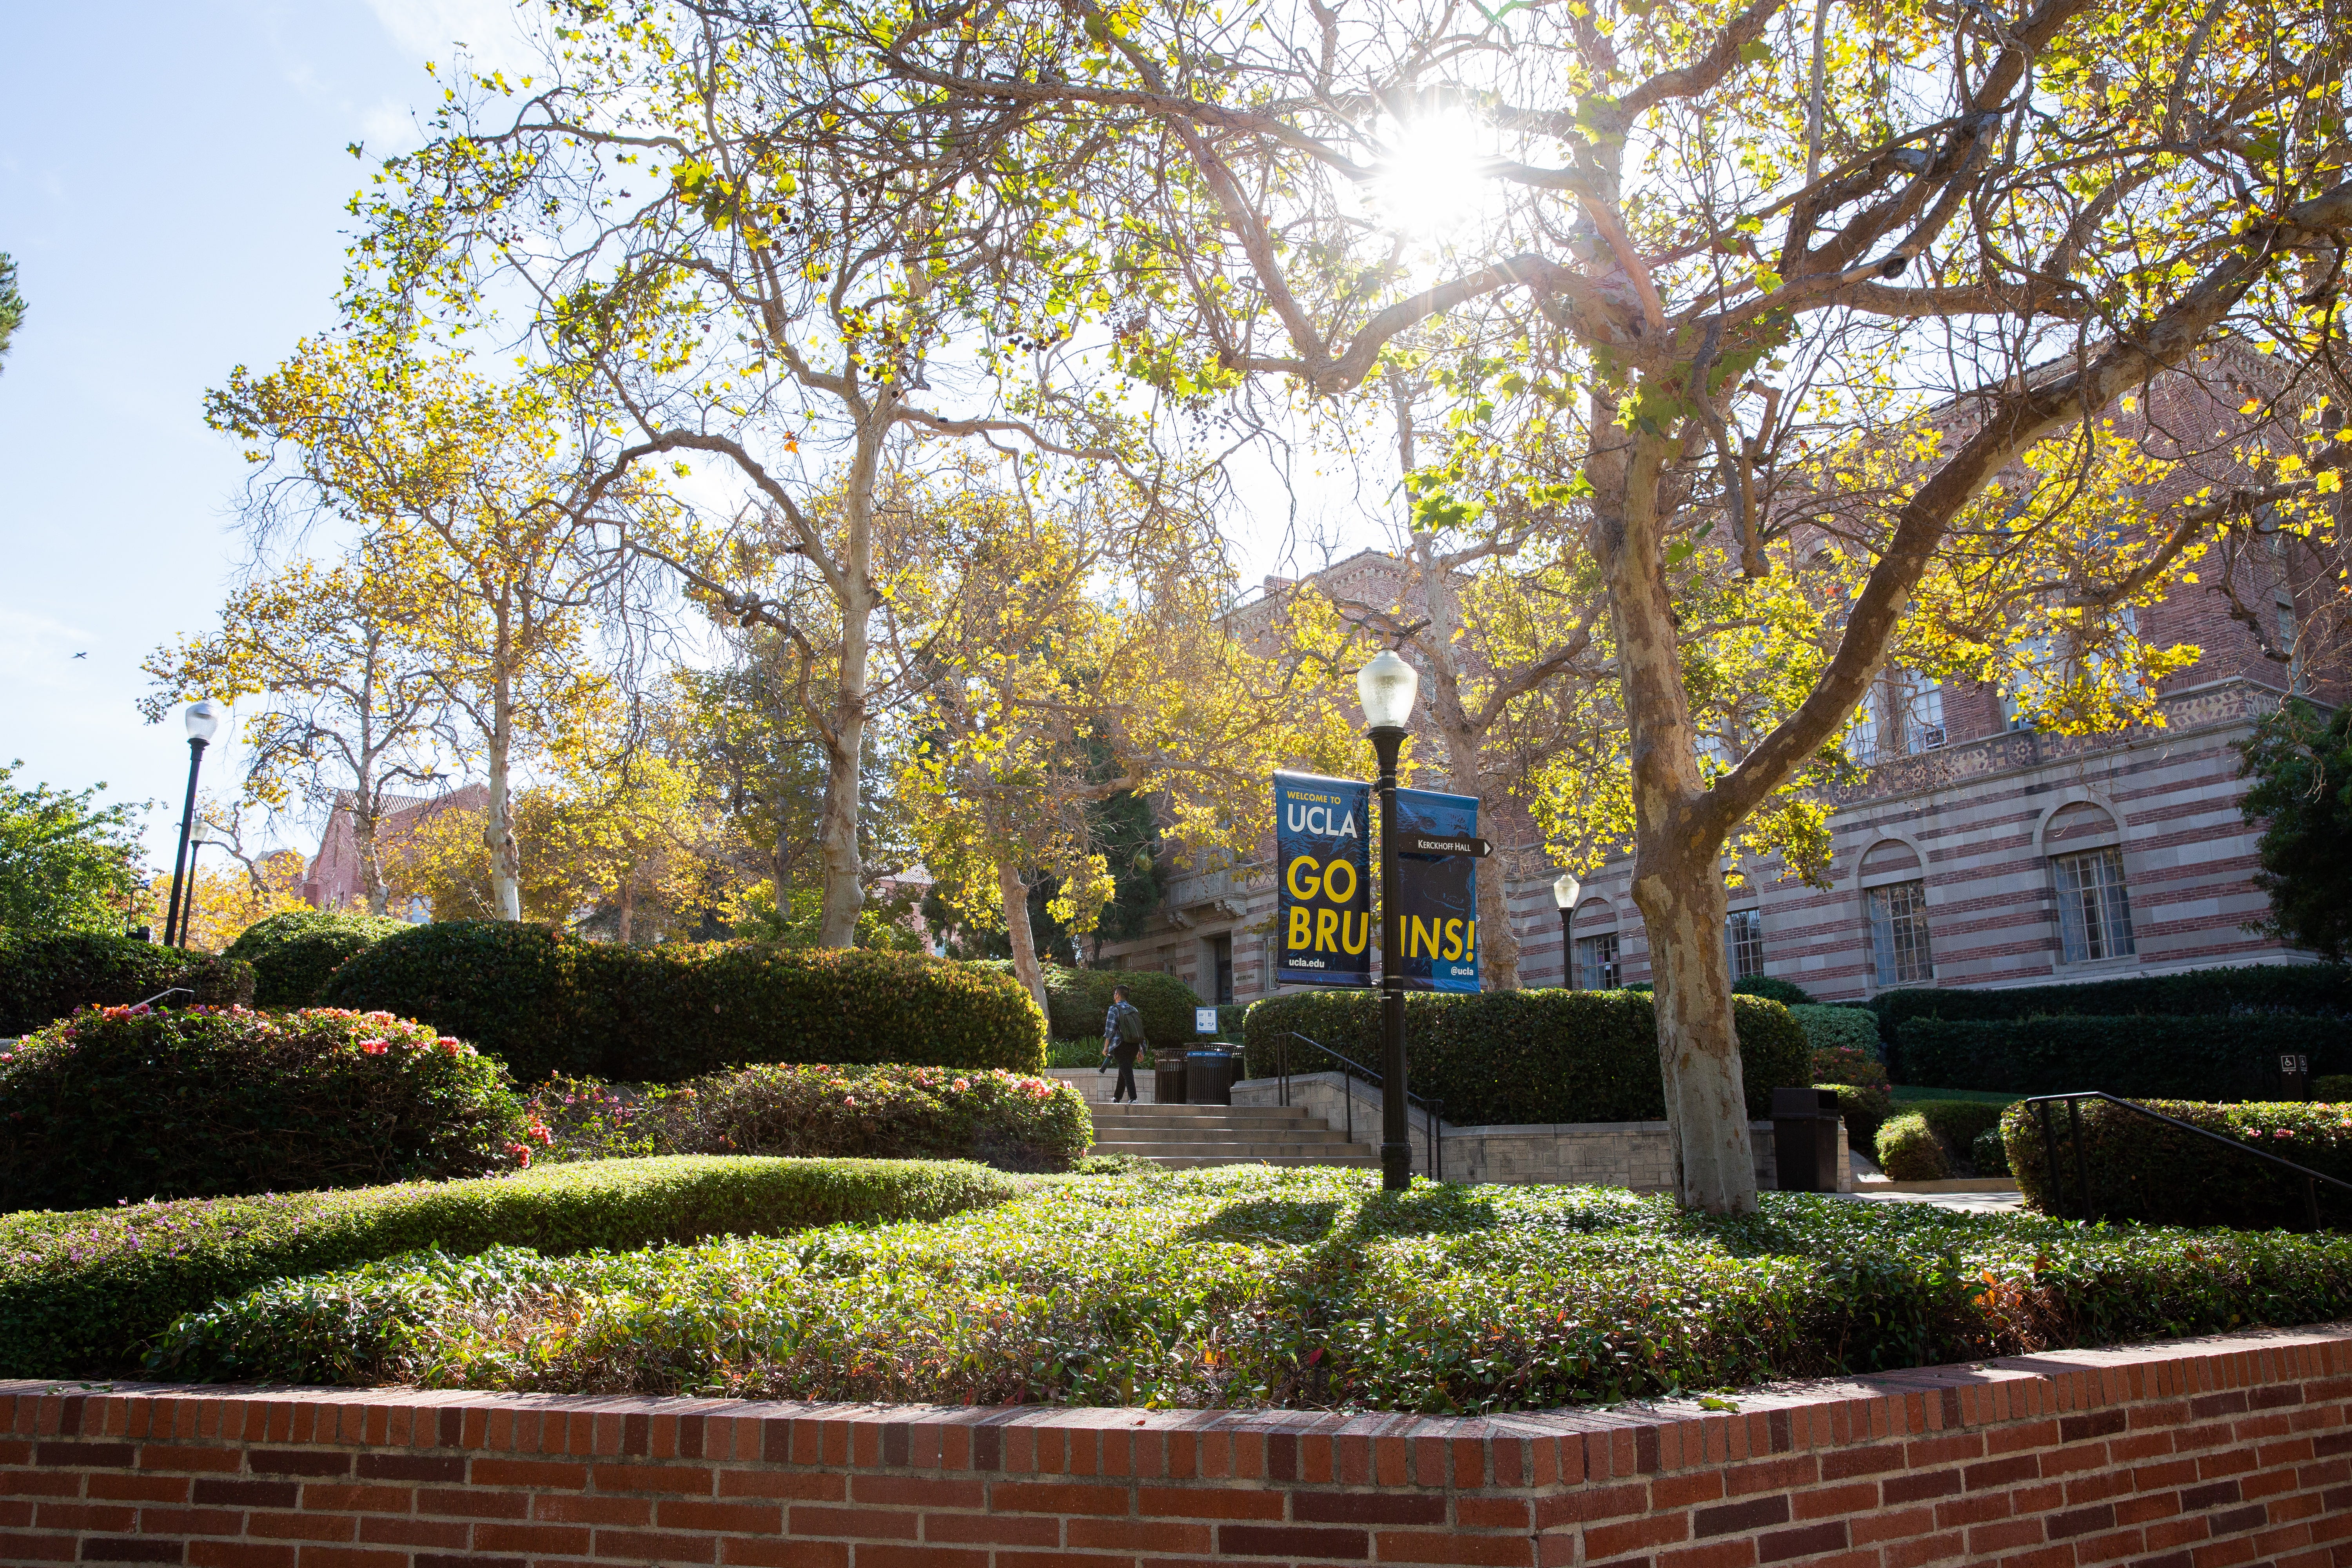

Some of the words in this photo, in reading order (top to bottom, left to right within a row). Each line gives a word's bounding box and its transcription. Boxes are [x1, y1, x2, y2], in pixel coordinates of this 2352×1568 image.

[1287, 791, 1327, 803] WELCOME
[1330, 796, 1341, 804] TO
[1288, 804, 1357, 838] UCLA
[1418, 840, 1454, 850] KERCKHOFF
[1455, 842, 1471, 851] HALL
[1287, 856, 1357, 903] GO
[1288, 906, 1369, 955] BRU
[1400, 915, 1475, 962] INS!
[1289, 958, 1325, 967] ucla.edu
[1451, 966, 1474, 975] @ucla
